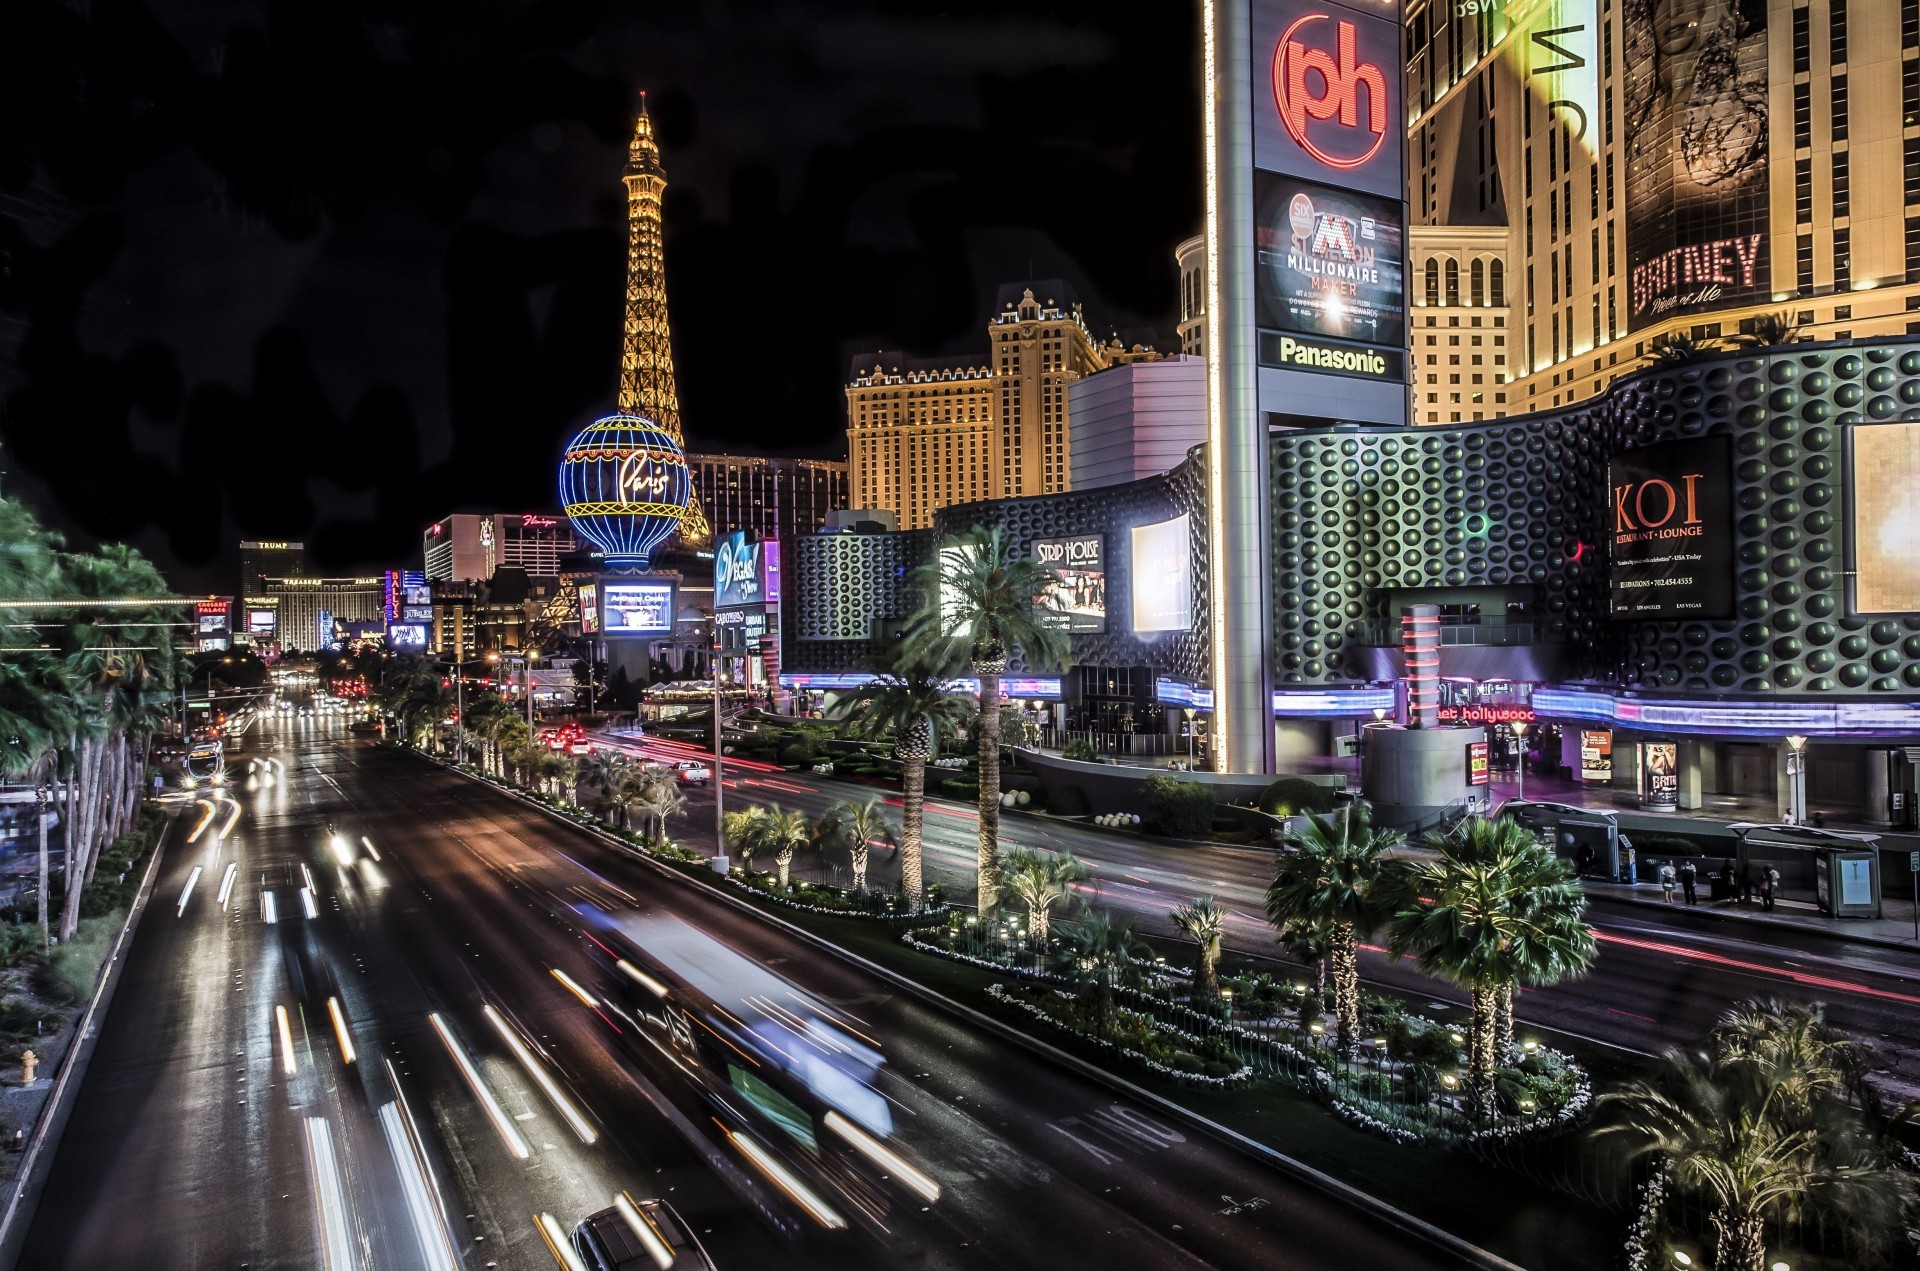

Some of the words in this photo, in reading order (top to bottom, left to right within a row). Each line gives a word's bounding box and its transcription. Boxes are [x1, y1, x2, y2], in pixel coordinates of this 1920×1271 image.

[1294, 202, 1310, 217] SIX
[1287, 254, 1378, 284] MILLIONAIRE
[1633, 234, 1761, 317] BRITNEY
[1311, 277, 1357, 296] MAKER
[1651, 295, 1677, 316] Piece
[1679, 292, 1695, 306] of
[1692, 284, 1722, 304] Me
[1280, 336, 1386, 374] Panasonic
[619, 449, 669, 508] Paris
[1614, 474, 1703, 533] KOI
[1659, 526, 1703, 539] LOUNGE
[1037, 543, 1064, 565] STRIP
[1065, 540, 1099, 566] HOUSE
[405, 610, 432, 619] JUBILEE
